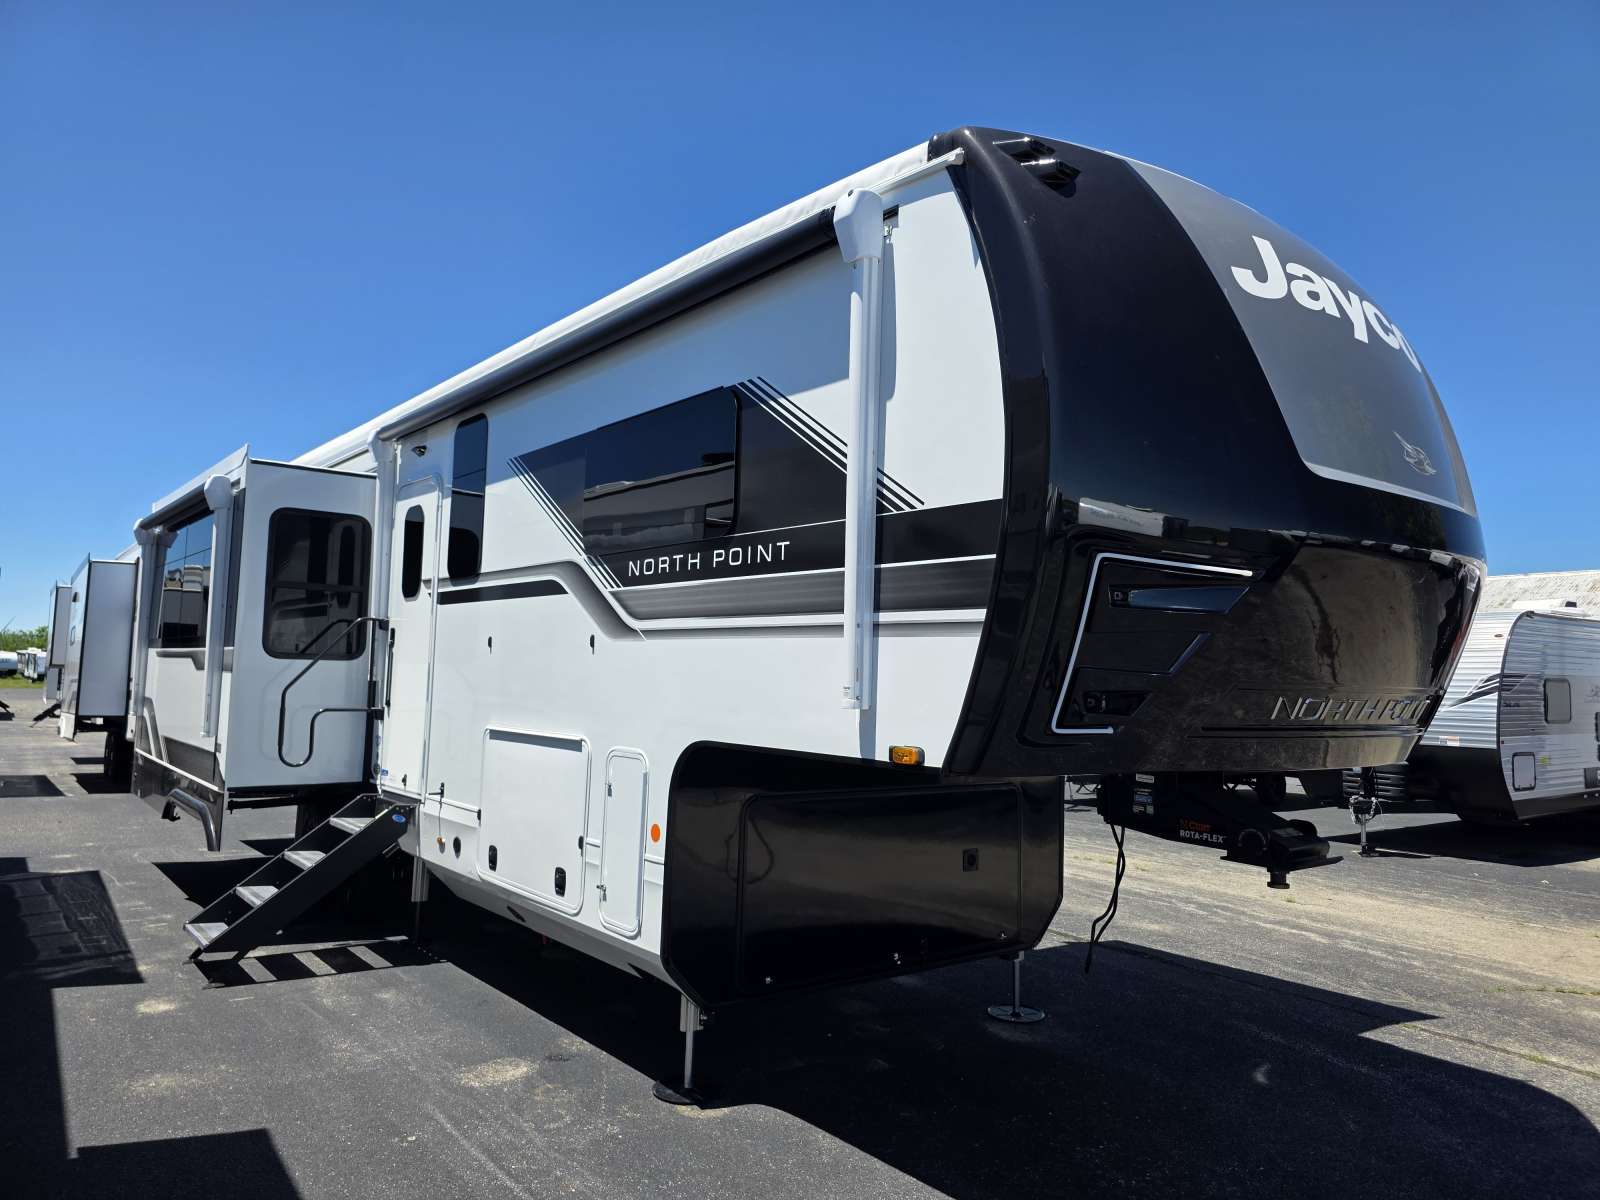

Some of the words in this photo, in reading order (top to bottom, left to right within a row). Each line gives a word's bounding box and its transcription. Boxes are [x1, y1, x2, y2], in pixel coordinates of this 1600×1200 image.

[628, 552, 701, 577] NORTH
[712, 541, 790, 568] POINT
[1270, 696, 1381, 720] NORTH
[1179, 829, 1224, 844] ROTA-FLEX
